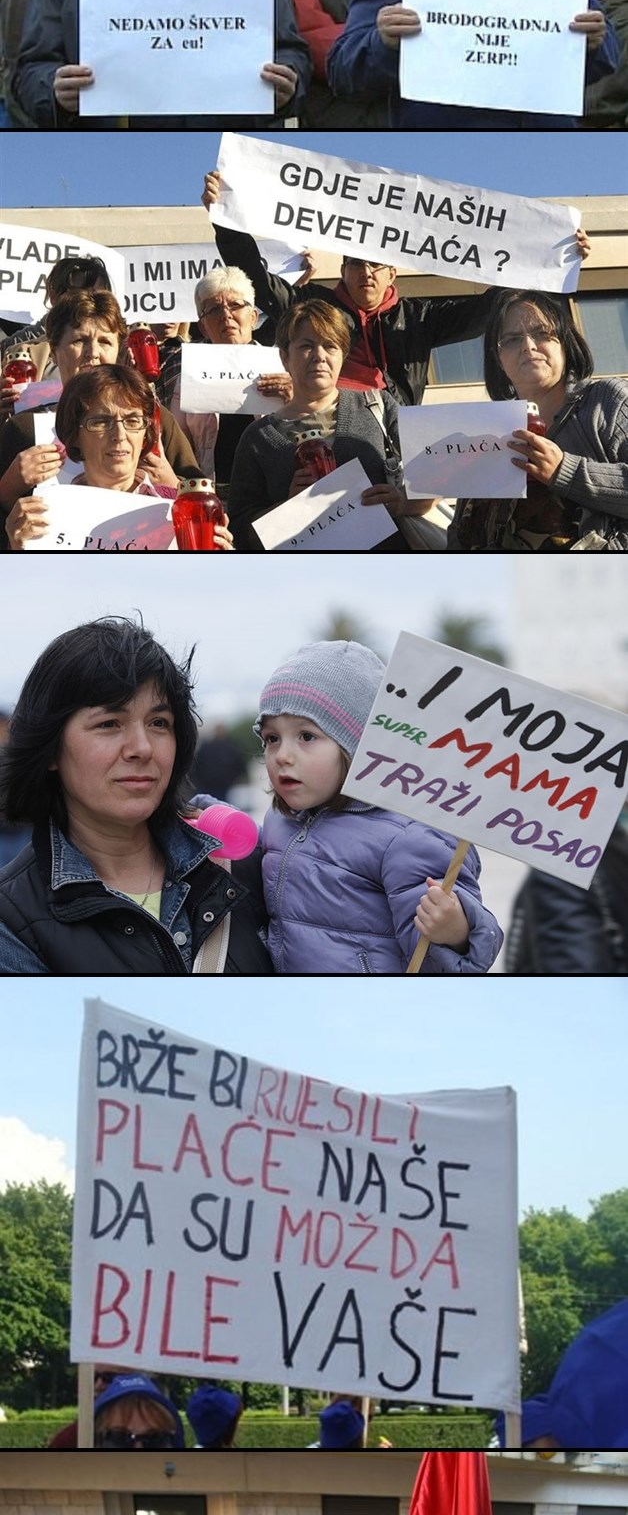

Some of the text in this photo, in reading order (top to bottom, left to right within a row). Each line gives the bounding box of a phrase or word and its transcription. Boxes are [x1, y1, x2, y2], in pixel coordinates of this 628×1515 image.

[109, 12, 246, 32] NEDAMO ŠKVER
[426, 9, 561, 34] BRODOGRADNJA
[150, 36, 204, 50] ZA eu!
[473, 32, 511, 49] NIJE
[465, 49, 518, 67] ZERP!!
[279, 161, 508, 232] GDJE JE NAŠIH
[274, 202, 511, 273] DEVET PLAĆA ?
[130, 261, 171, 282] I MI
[220, 370, 262, 379] PLAĆ
[425, 438, 502, 456] 8. PLAĆA
[308, 503, 356, 536] PLAĆA
[56, 532, 72, 546] 5.
[465, 688, 628, 788] MOJA
[370, 712, 599, 821] SUPER MAMA
[354, 751, 601, 869] TRAŽI POSAO
[97, 1028, 198, 1102] BRŽE
[210, 1049, 247, 1109] BI
[94, 1098, 471, 1231] PLAĆE NAŠE
[90, 1178, 461, 1289] DA SU MOŽDA
[91, 1264, 477, 1401] BILE VAŠE
